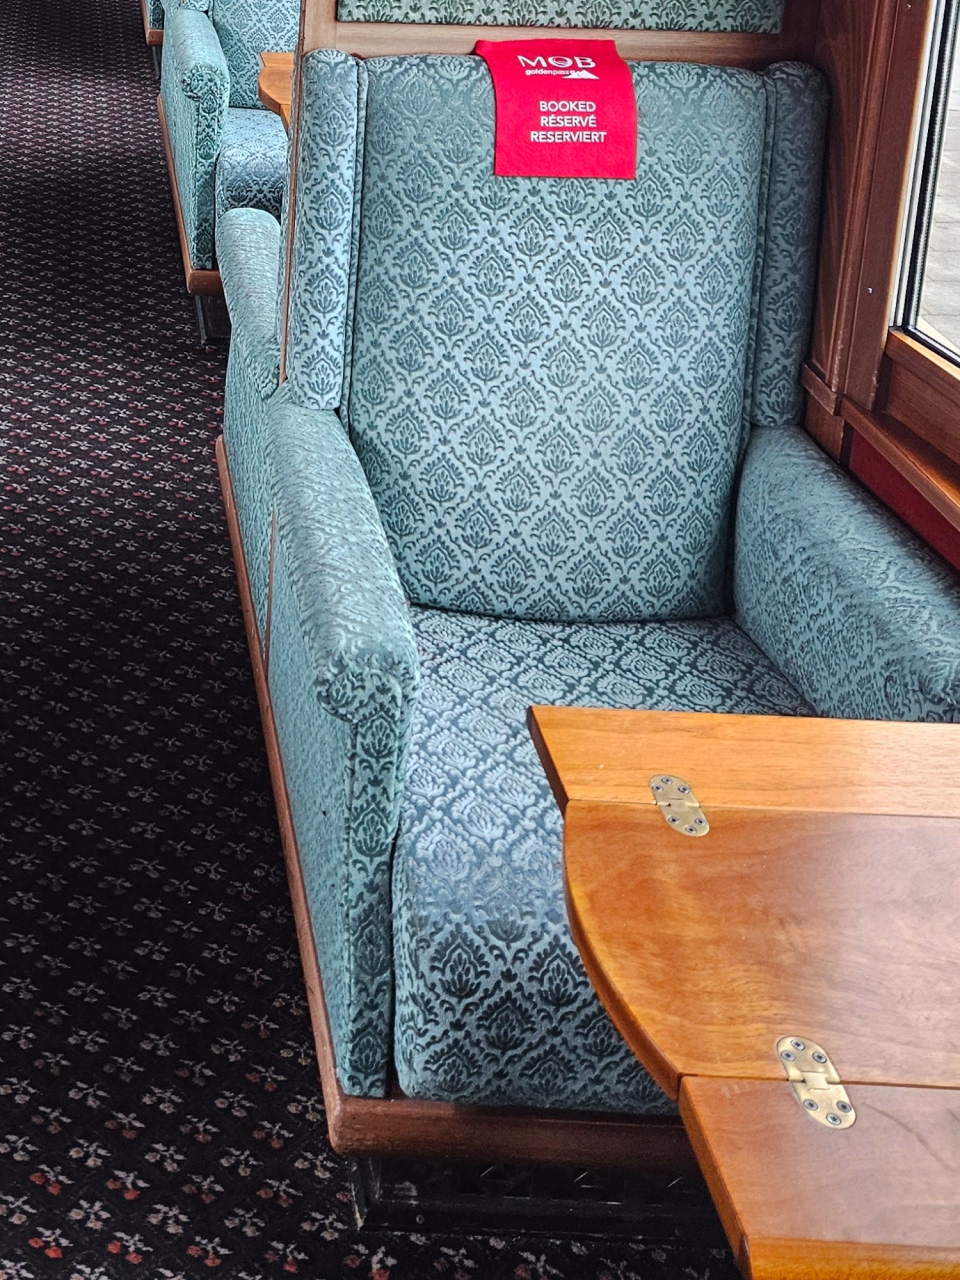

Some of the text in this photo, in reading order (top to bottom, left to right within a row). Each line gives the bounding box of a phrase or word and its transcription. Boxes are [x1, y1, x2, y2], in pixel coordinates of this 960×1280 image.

[517, 55, 596, 68] MOB
[539, 101, 596, 112] BOOKED
[540, 114, 597, 127] RÉSERVÉ
[530, 131, 607, 143] RESERVIERT
